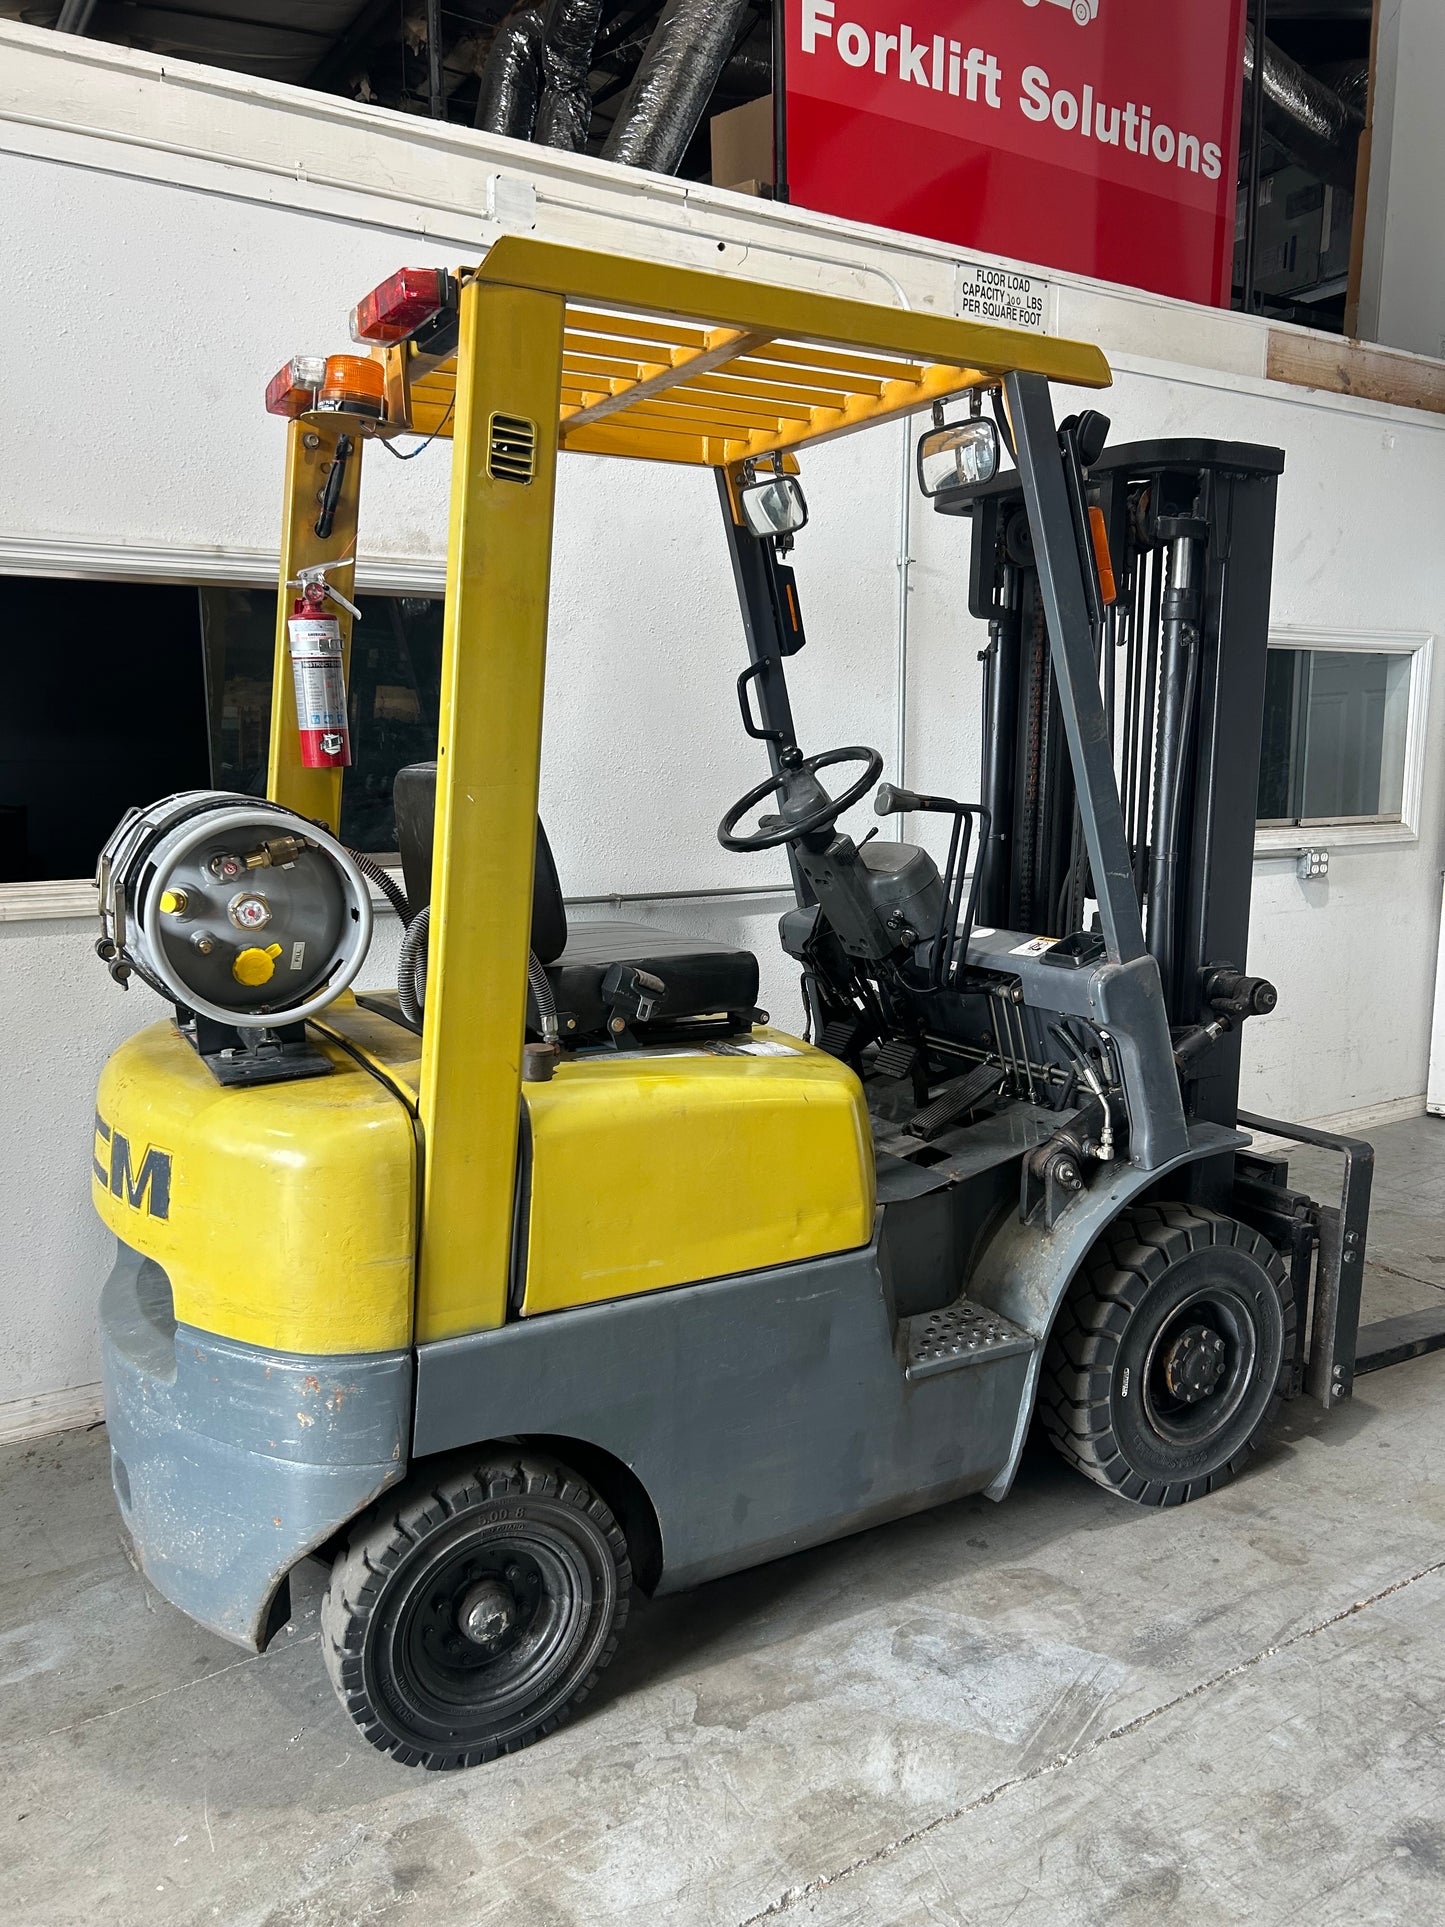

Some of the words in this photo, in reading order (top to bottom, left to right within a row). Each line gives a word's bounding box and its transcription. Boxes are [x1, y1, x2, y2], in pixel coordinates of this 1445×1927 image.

[801, 0, 1002, 109] Forklift
[1019, 65, 1222, 180] Solutions
[976, 269, 1006, 288] FLOOR
[1007, 276, 1030, 293] LOAD
[962, 282, 1005, 303] CAPACITY
[1026, 296, 1043, 311] LBS
[962, 298, 981, 313] PER
[982, 302, 1018, 321] SQUARE
[1019, 310, 1042, 326] FOOT
